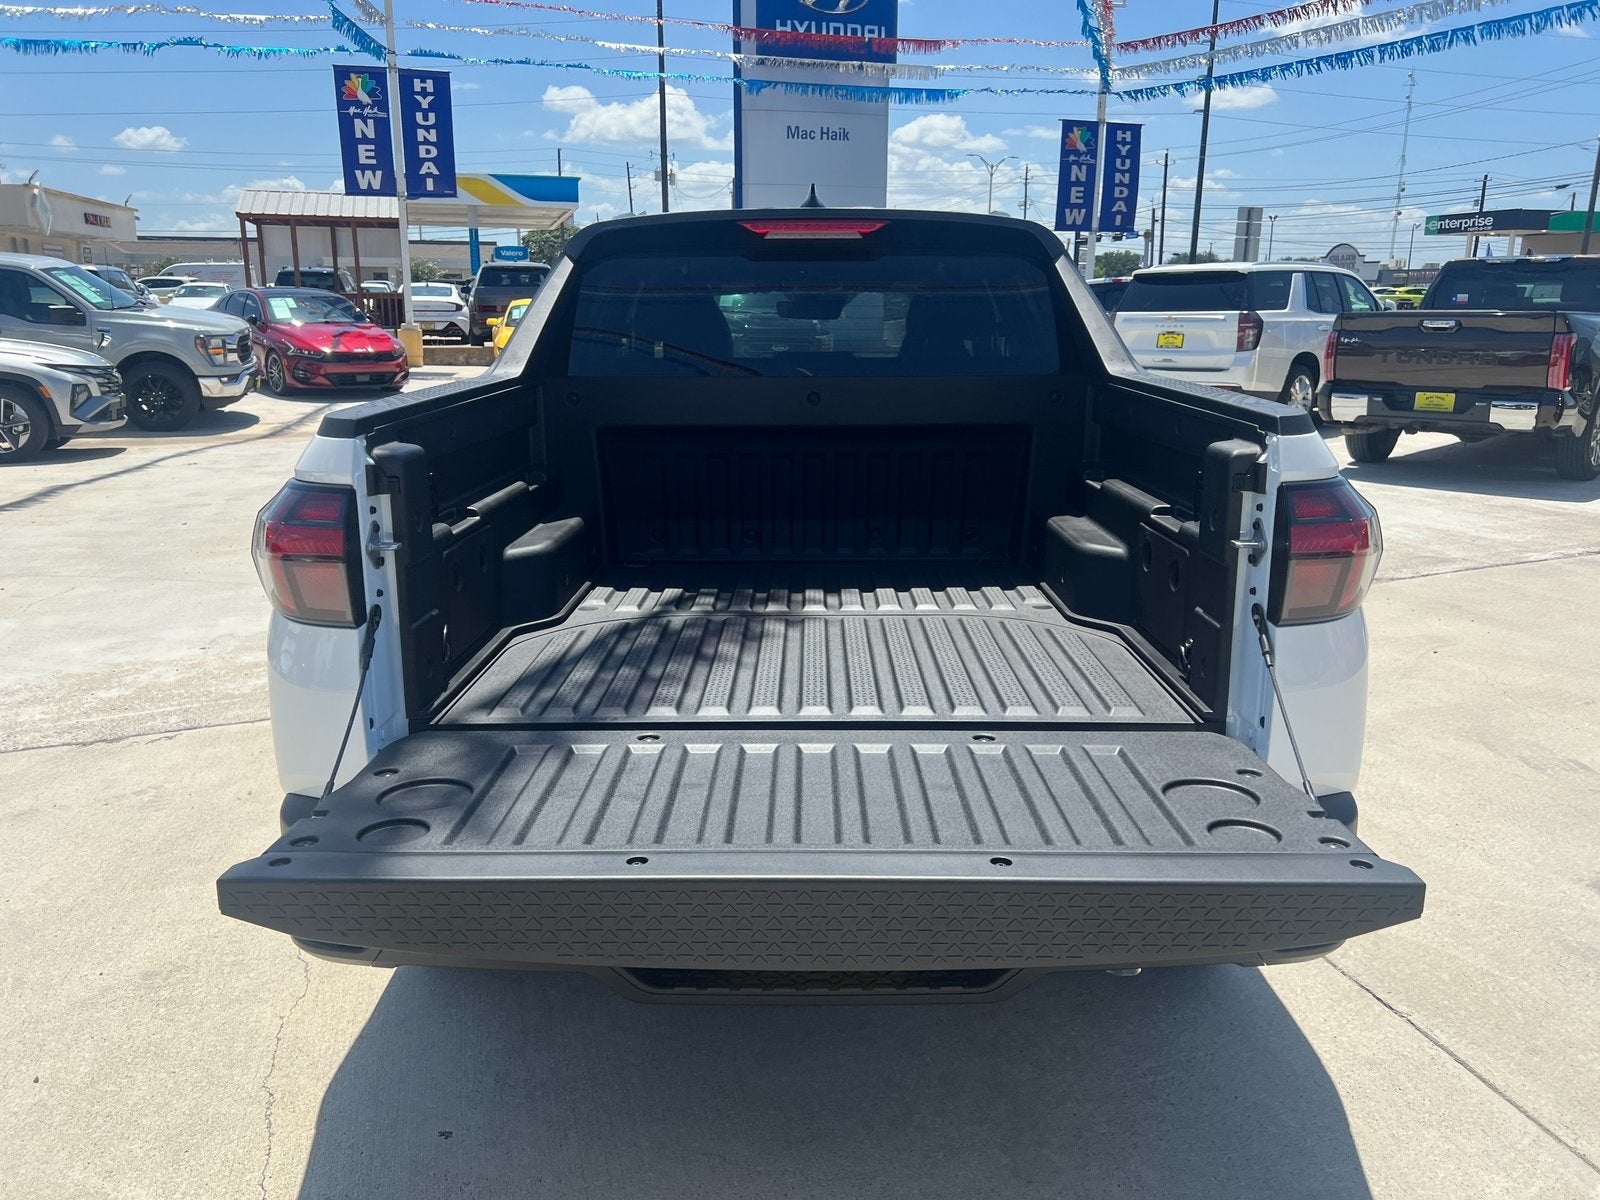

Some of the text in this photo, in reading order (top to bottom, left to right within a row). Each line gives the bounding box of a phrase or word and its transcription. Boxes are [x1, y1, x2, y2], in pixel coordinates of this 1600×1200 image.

[413, 78, 440, 191] HYUNDAI
[786, 125, 850, 141] Mac Haik
[354, 118, 383, 190] NEW
[1065, 165, 1087, 225] NEW
[1111, 130, 1131, 226] HYUNDAI
[1427, 215, 1494, 231] enterprise
[500, 249, 524, 257] Valero
[1375, 350, 1499, 366] TUNDRA
